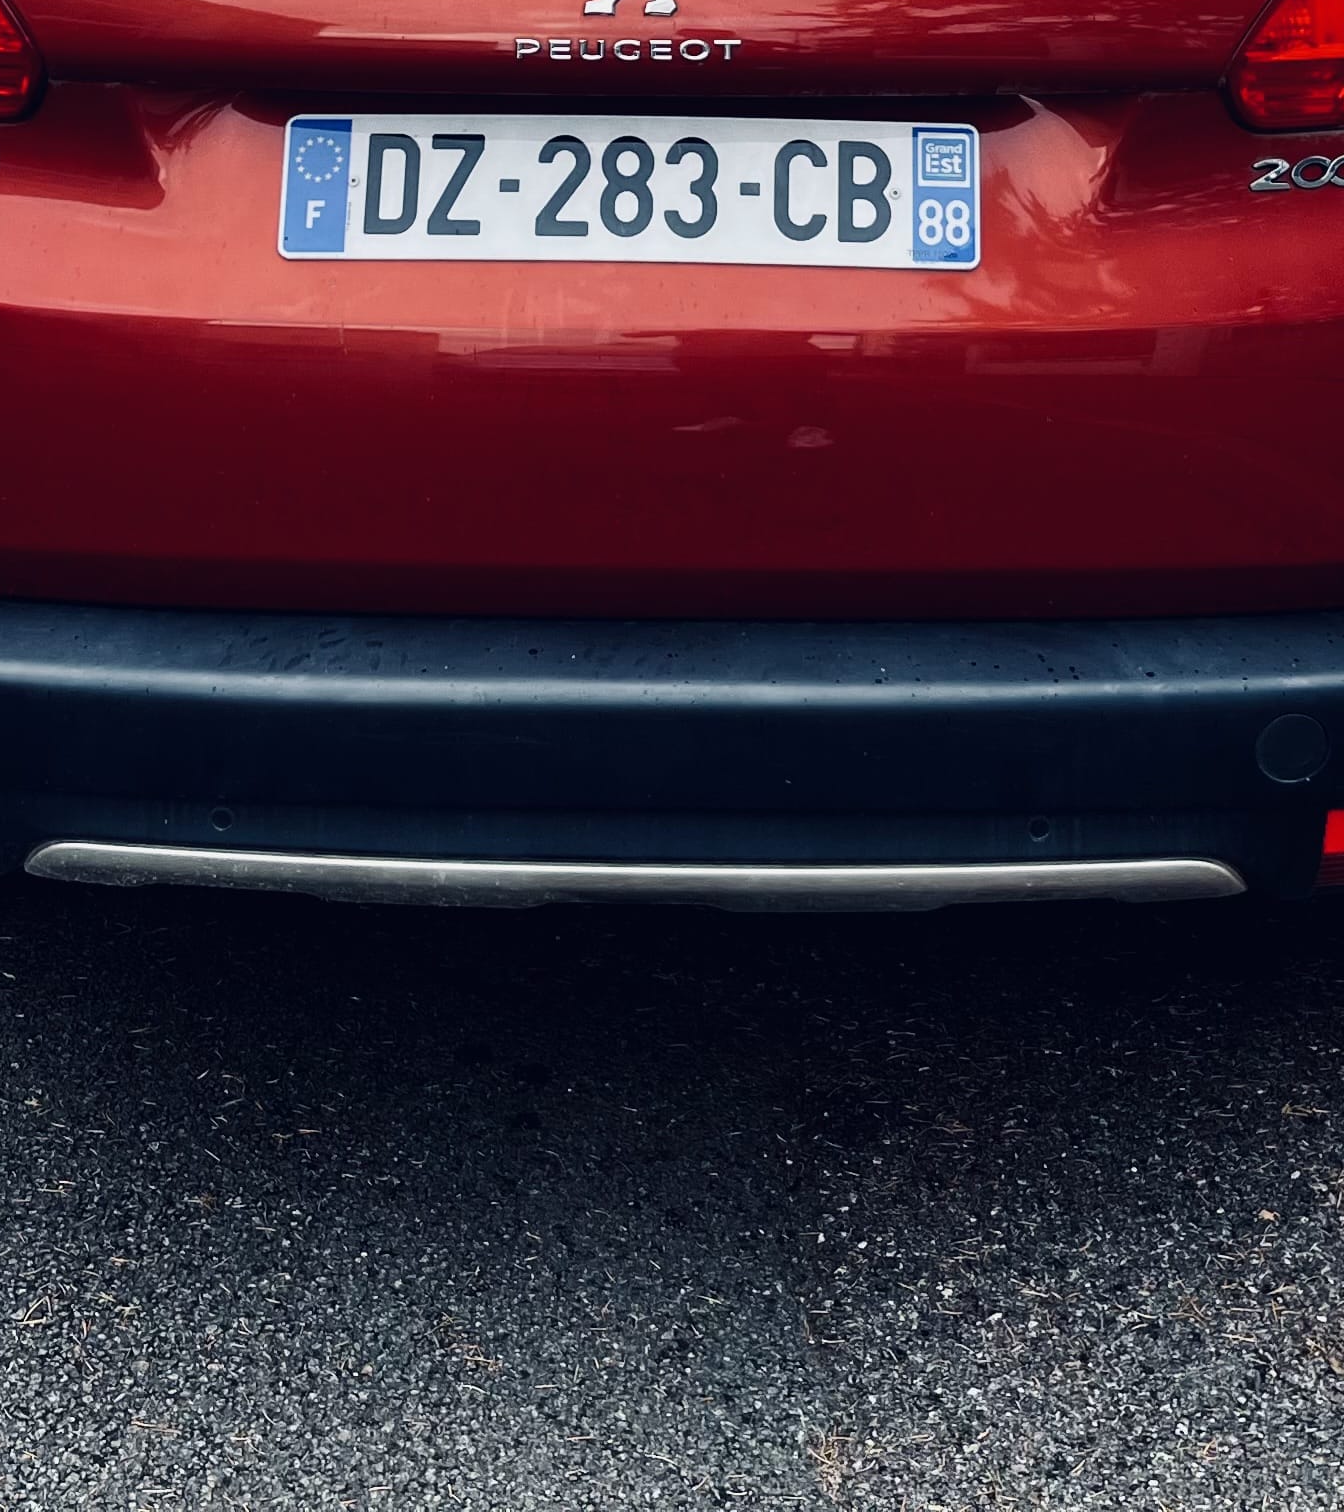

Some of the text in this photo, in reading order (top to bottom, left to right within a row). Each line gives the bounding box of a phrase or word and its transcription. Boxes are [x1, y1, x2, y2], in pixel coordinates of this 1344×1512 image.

[515, 38, 742, 61] PEUGEOT
[924, 142, 963, 155] Grand
[924, 154, 963, 174] Est
[363, 133, 893, 244] DZ-283-CB
[305, 199, 326, 230] F
[918, 198, 971, 247] 88
